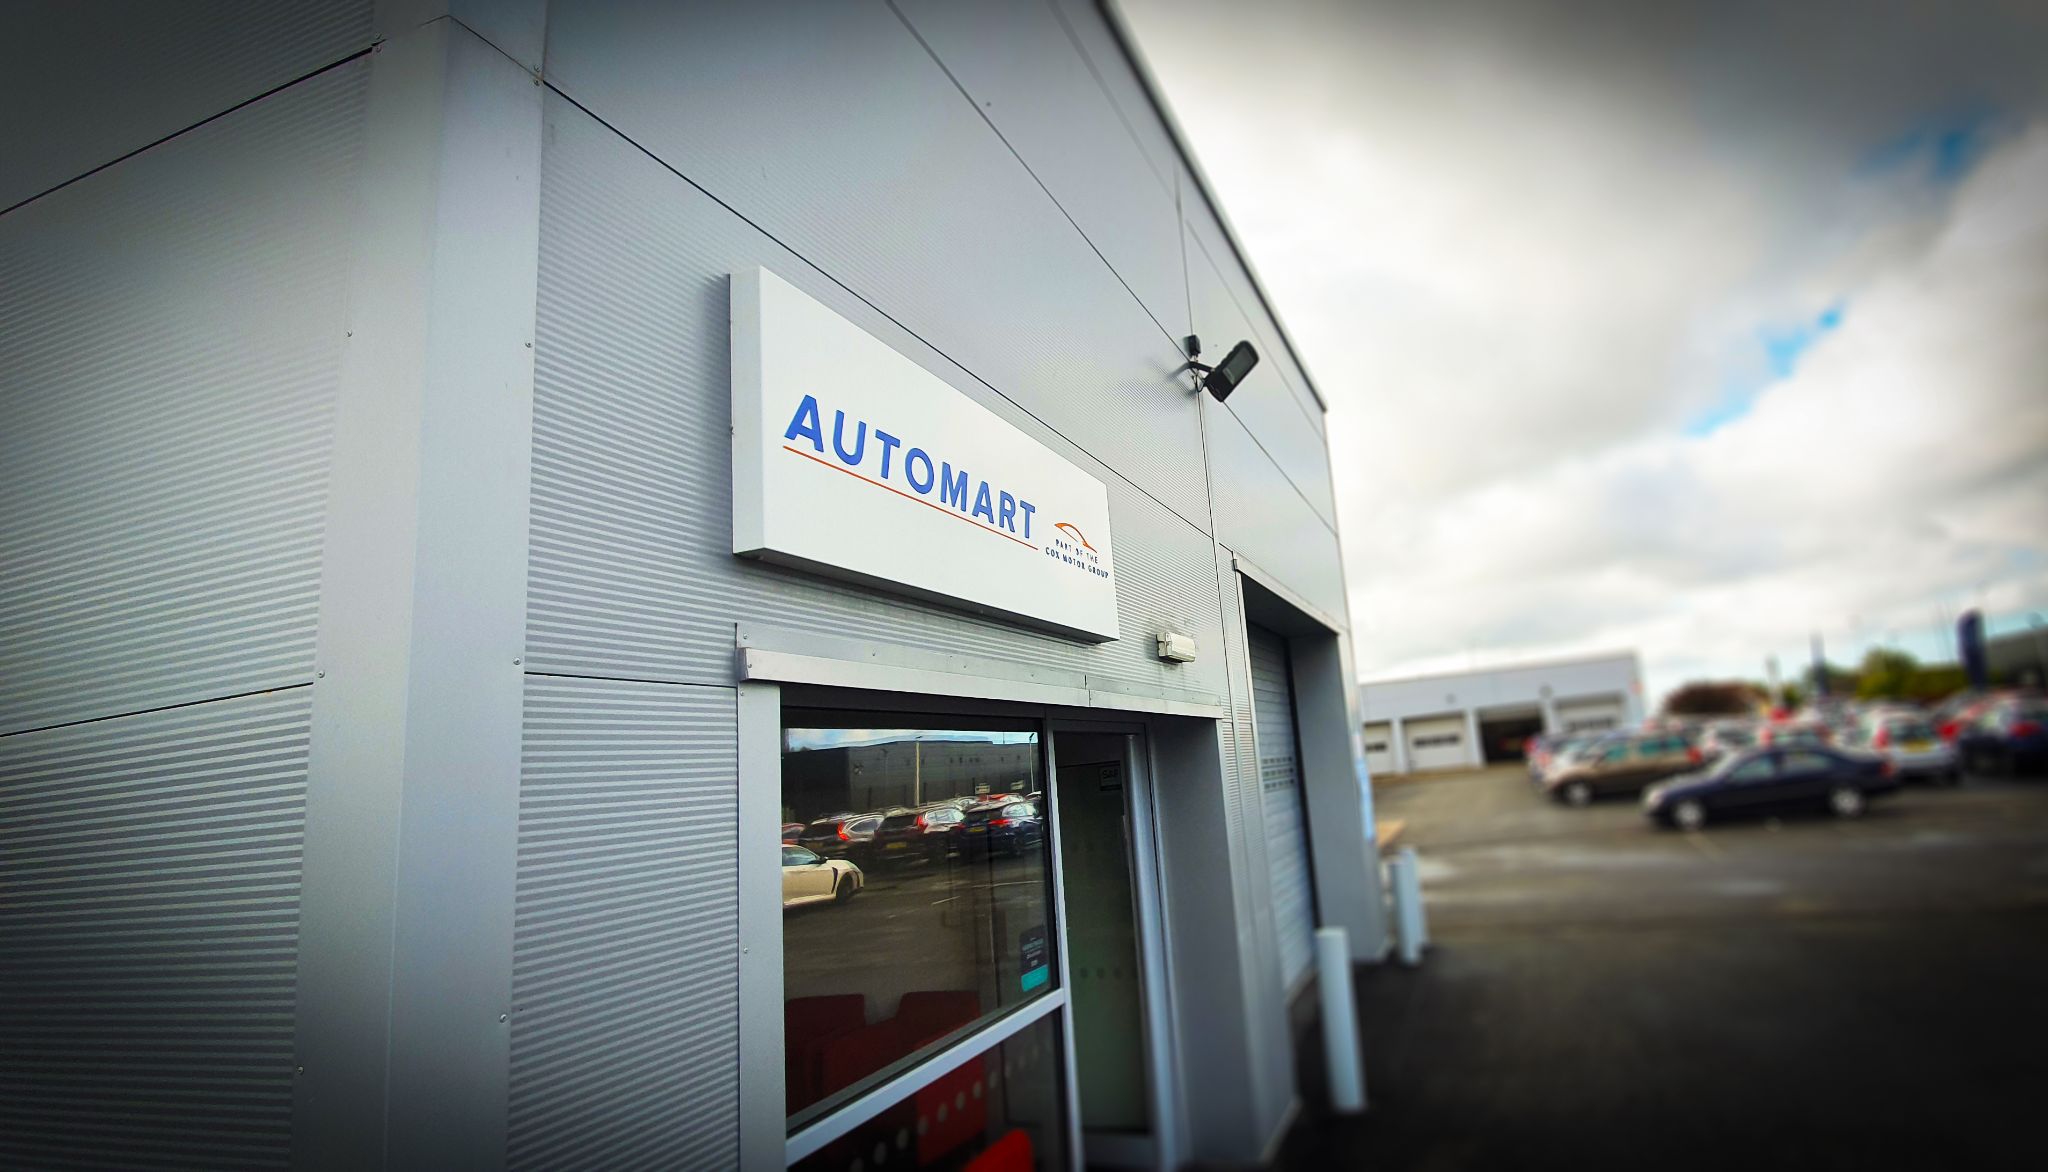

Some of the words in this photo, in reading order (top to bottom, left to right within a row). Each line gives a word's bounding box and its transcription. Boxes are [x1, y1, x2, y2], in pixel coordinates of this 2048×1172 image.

[784, 394, 1036, 539] AUTOMART
[1045, 547, 1060, 559] COX
[1062, 554, 1085, 569] MOTOR
[1087, 565, 1109, 579] GROUP
[1055, 539, 1072, 552] PART
[1075, 548, 1083, 557] OF
[1086, 553, 1098, 564] THE
